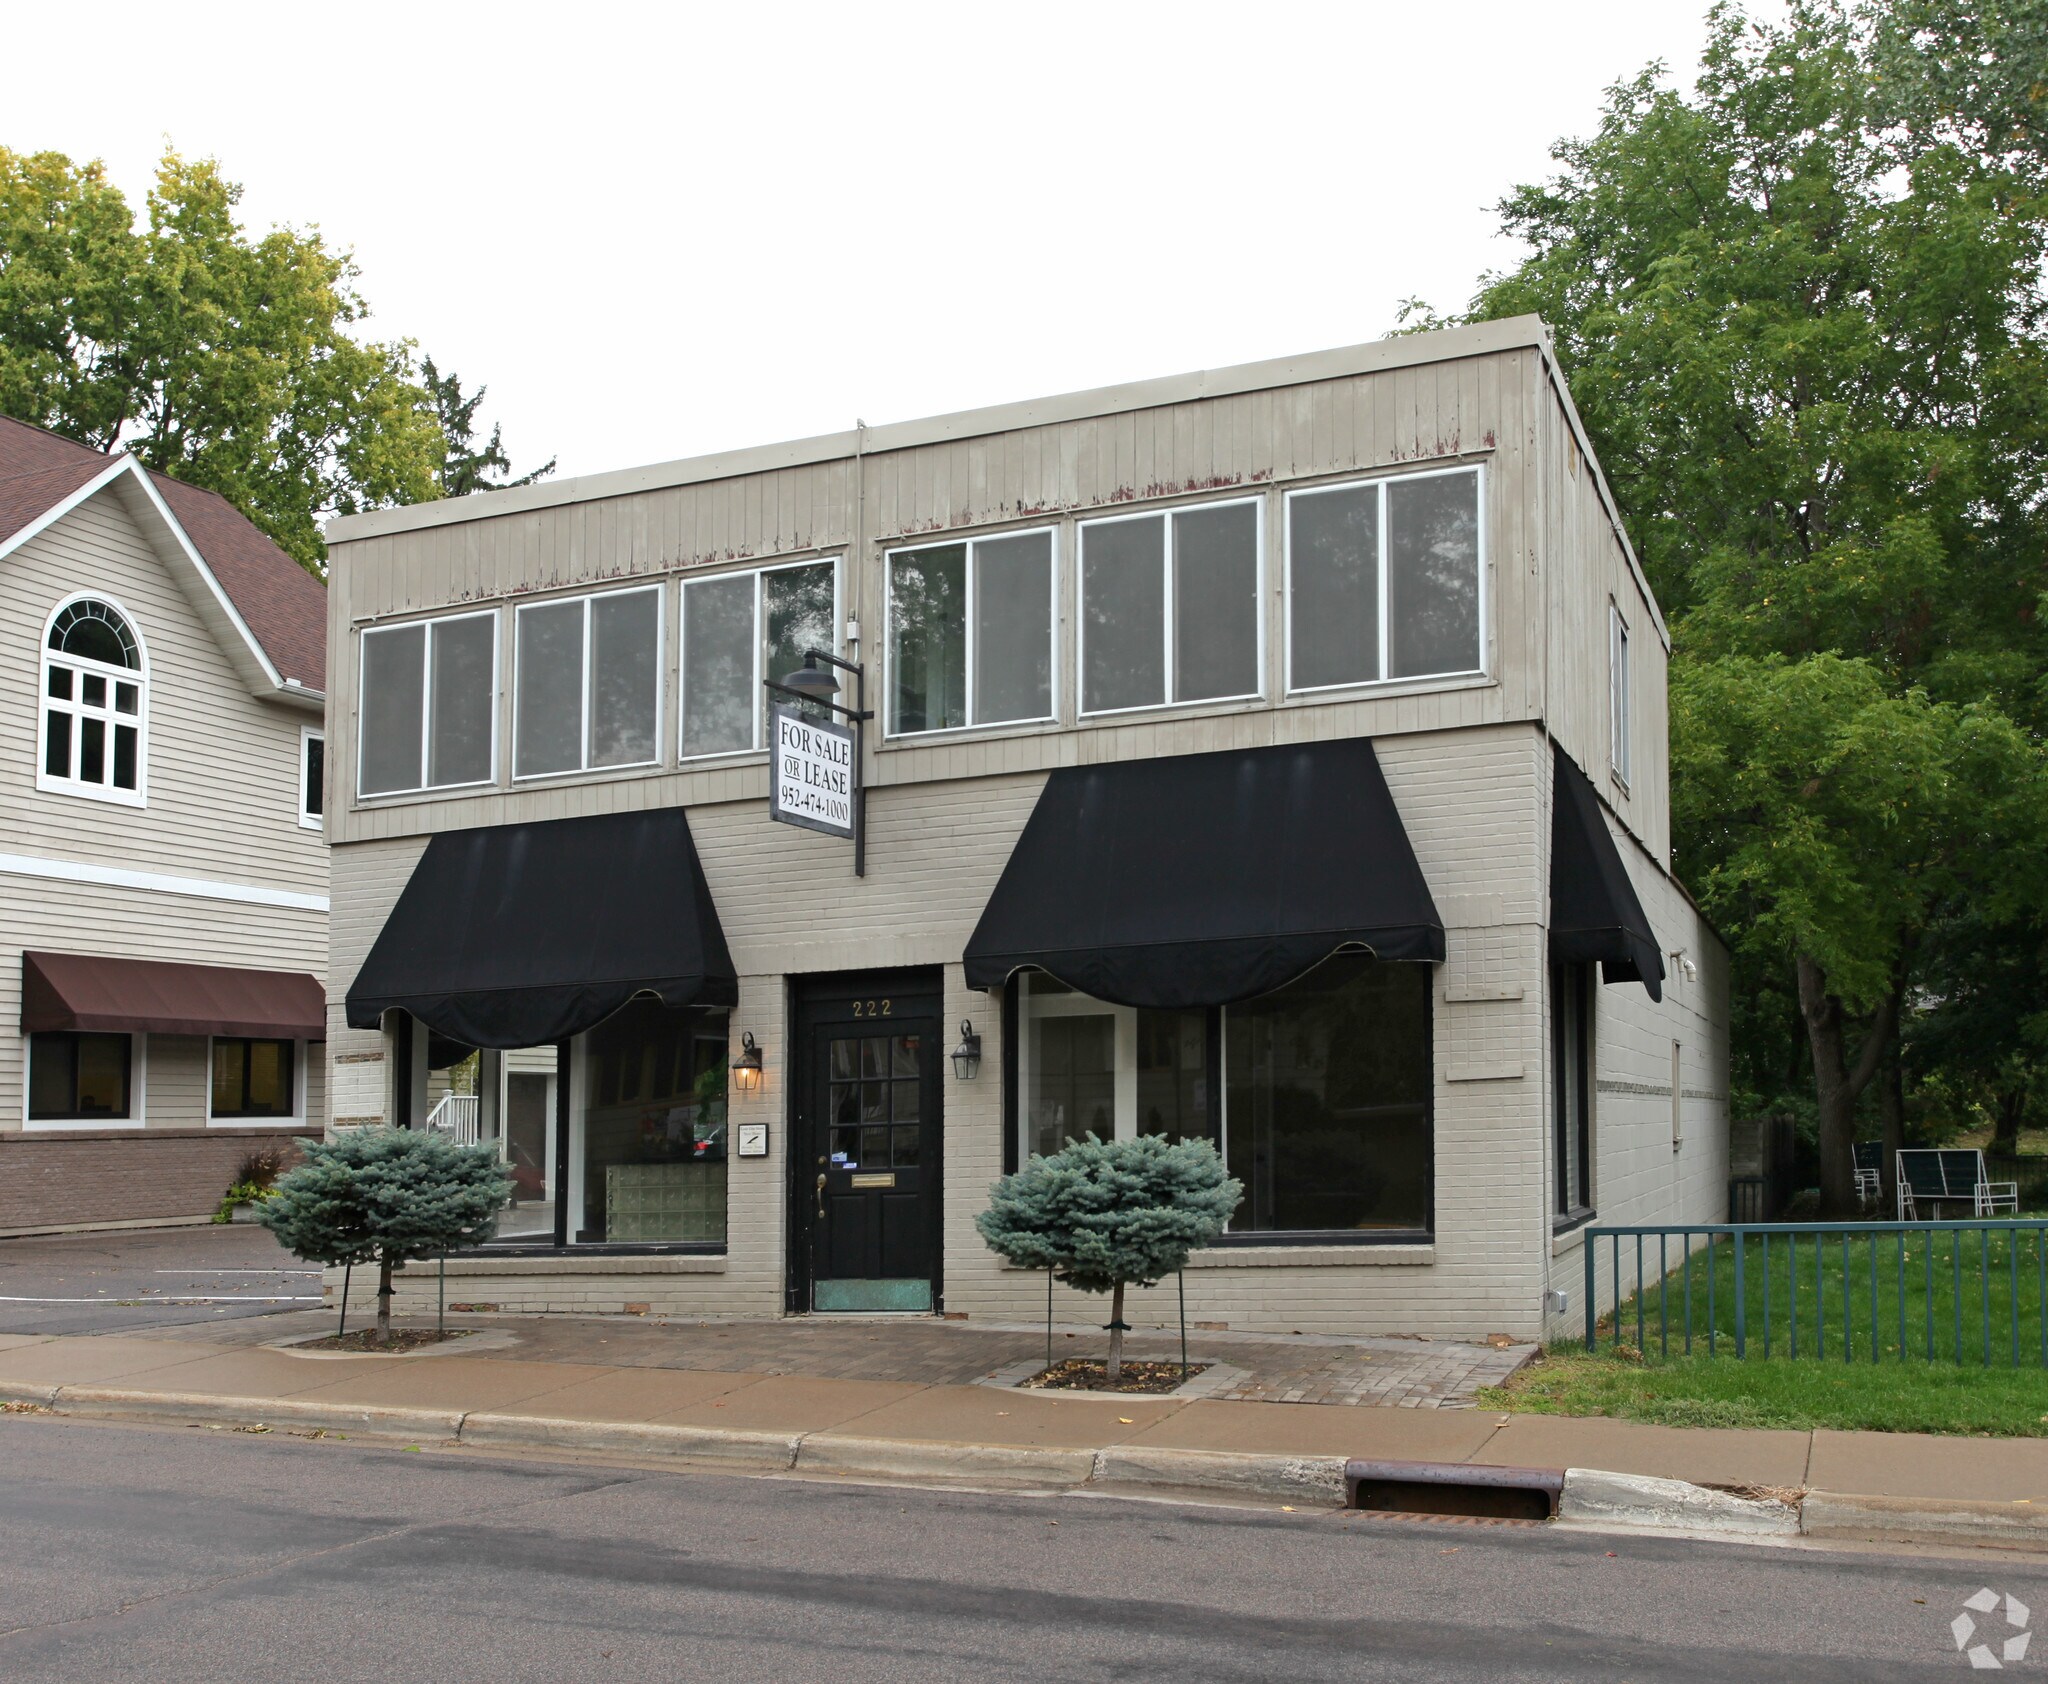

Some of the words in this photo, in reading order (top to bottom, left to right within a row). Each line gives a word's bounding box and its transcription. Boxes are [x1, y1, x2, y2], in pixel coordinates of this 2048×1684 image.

[781, 722, 811, 753] FOR
[815, 734, 849, 766] SALE
[784, 758, 800, 777] OR
[804, 760, 847, 795] LEASE
[853, 999, 891, 1016] 222
